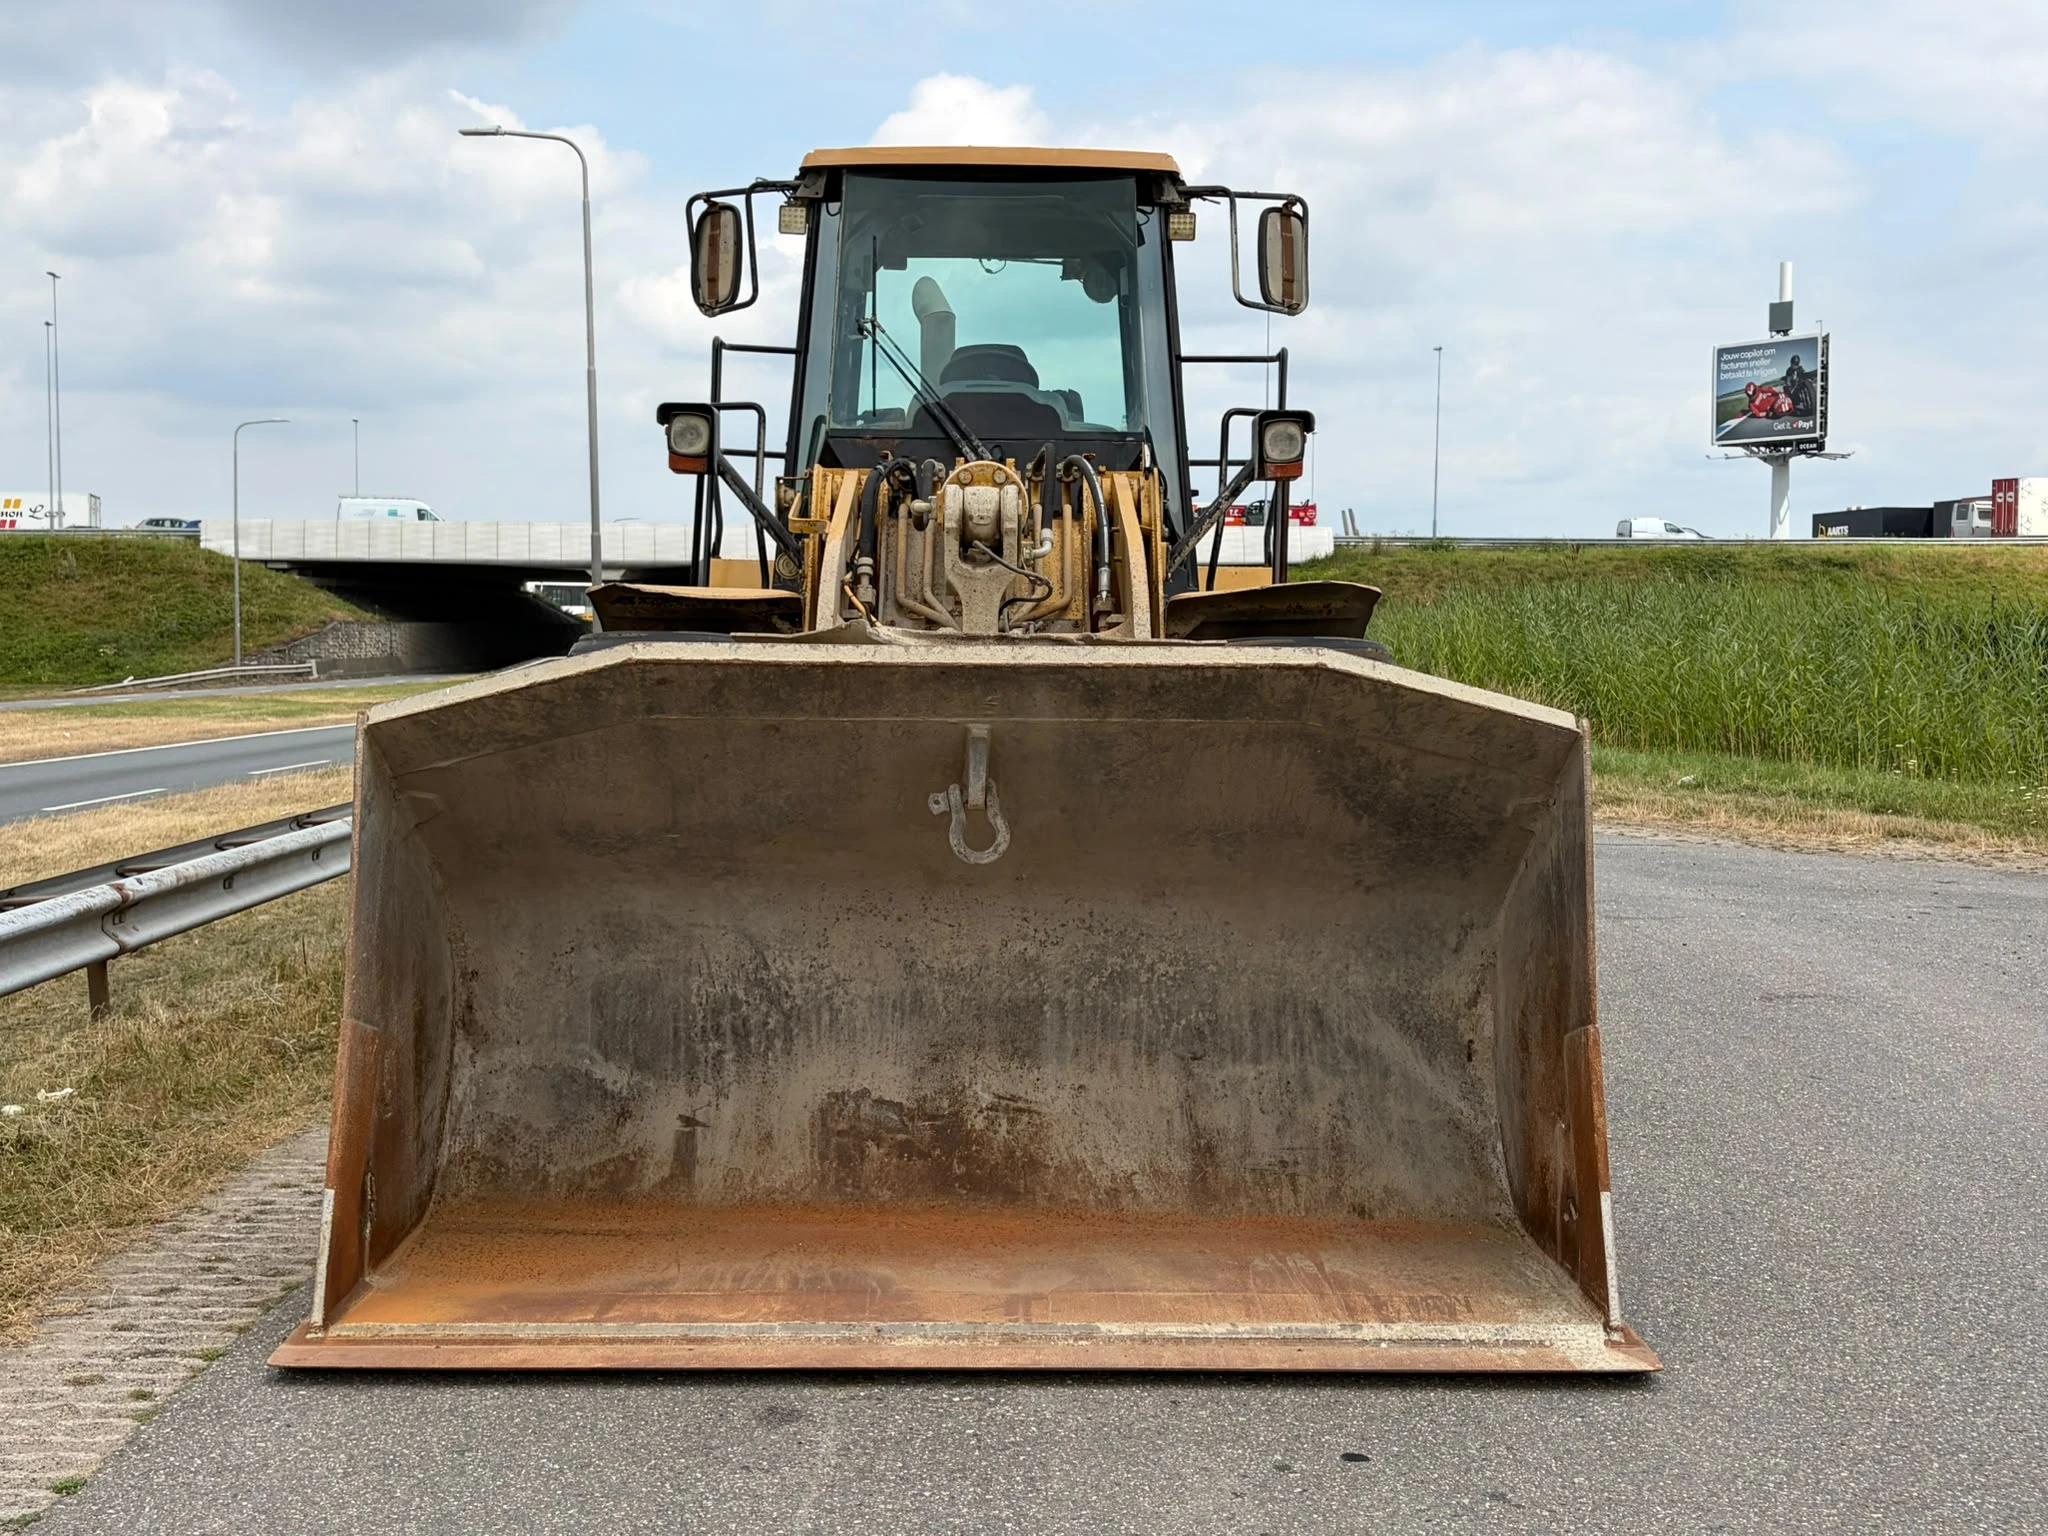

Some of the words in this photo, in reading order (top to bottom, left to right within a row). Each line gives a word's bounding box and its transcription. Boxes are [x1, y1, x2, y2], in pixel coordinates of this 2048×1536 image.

[1720, 352, 1740, 361] Jouw
[1740, 349, 1763, 359] copilot
[1763, 348, 1776, 356] om
[1720, 361, 1748, 370] facturen
[1720, 369, 1746, 380] betaald
[1773, 421, 1786, 430] Get
[1798, 420, 1813, 430] Payt
